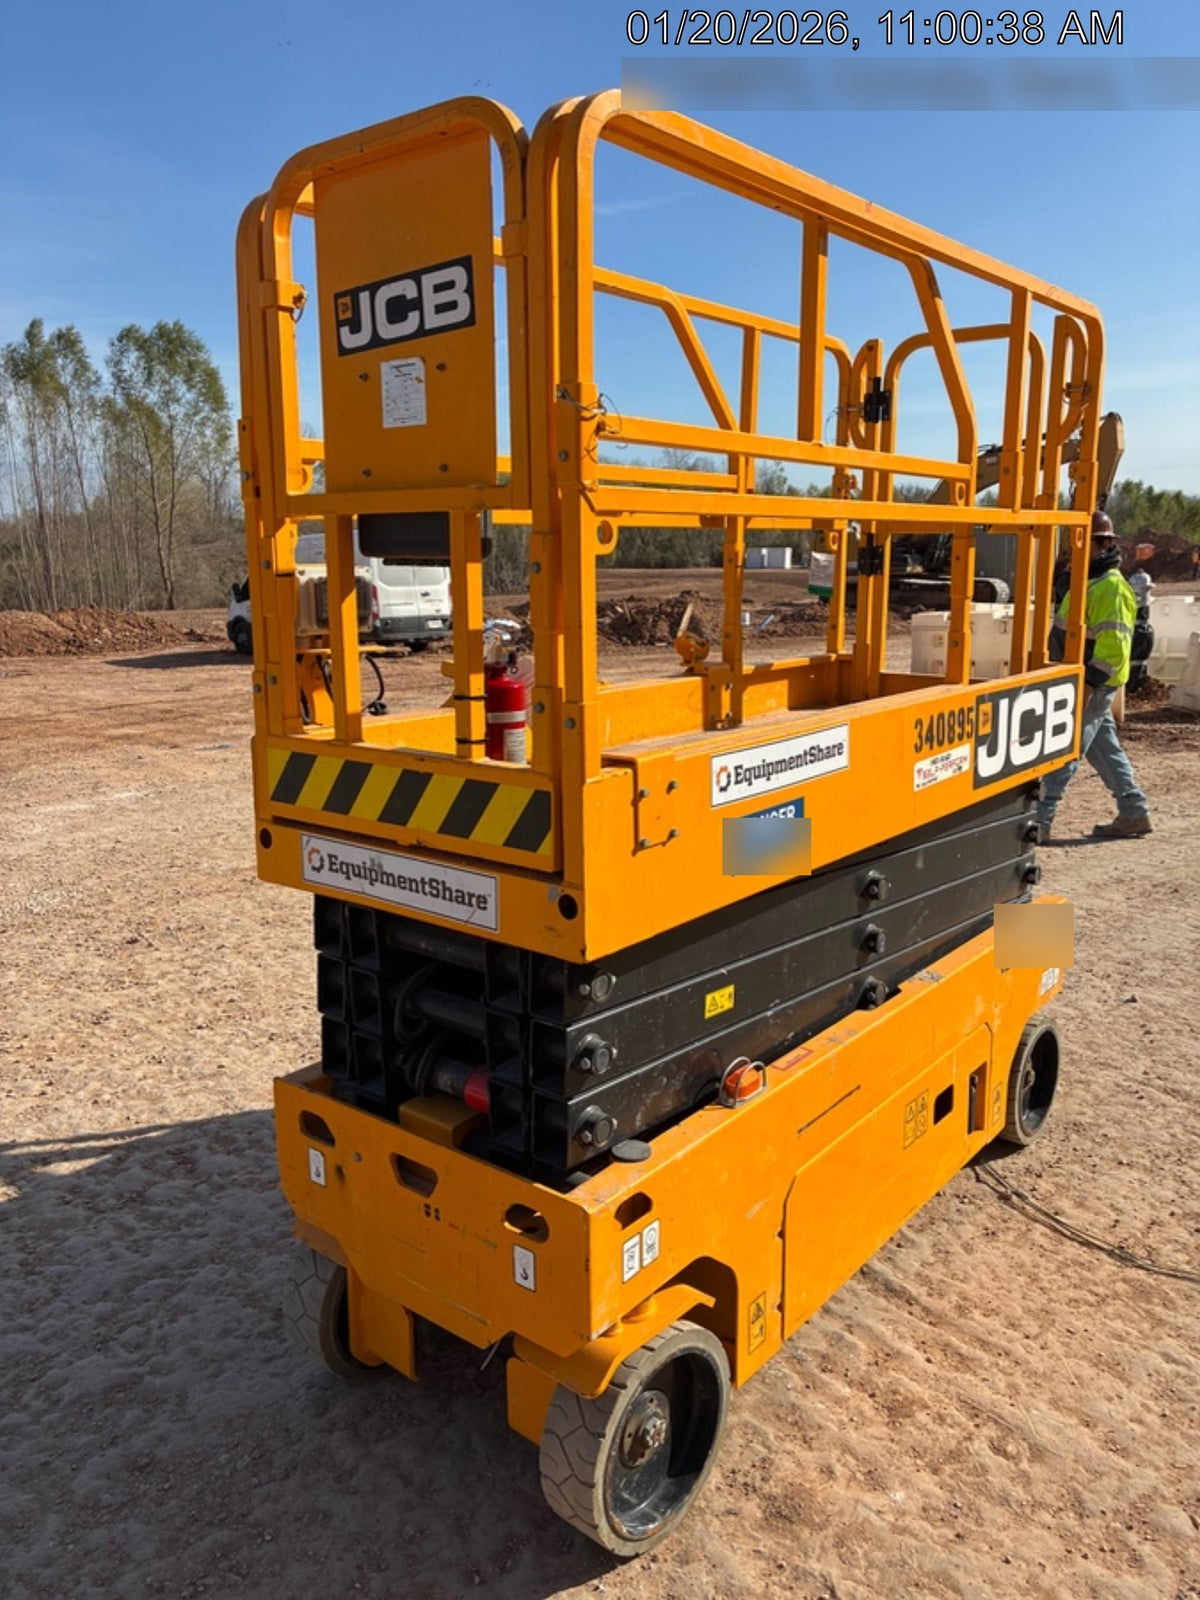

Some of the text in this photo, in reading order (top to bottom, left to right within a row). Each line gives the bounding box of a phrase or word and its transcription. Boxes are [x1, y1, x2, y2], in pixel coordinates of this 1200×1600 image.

[339, 265, 471, 350] JCB
[913, 706, 974, 753] 340895
[977, 682, 1075, 779] JCB
[733, 740, 845, 788] EquipmentShare
[326, 853, 488, 911] EquipmentShare
